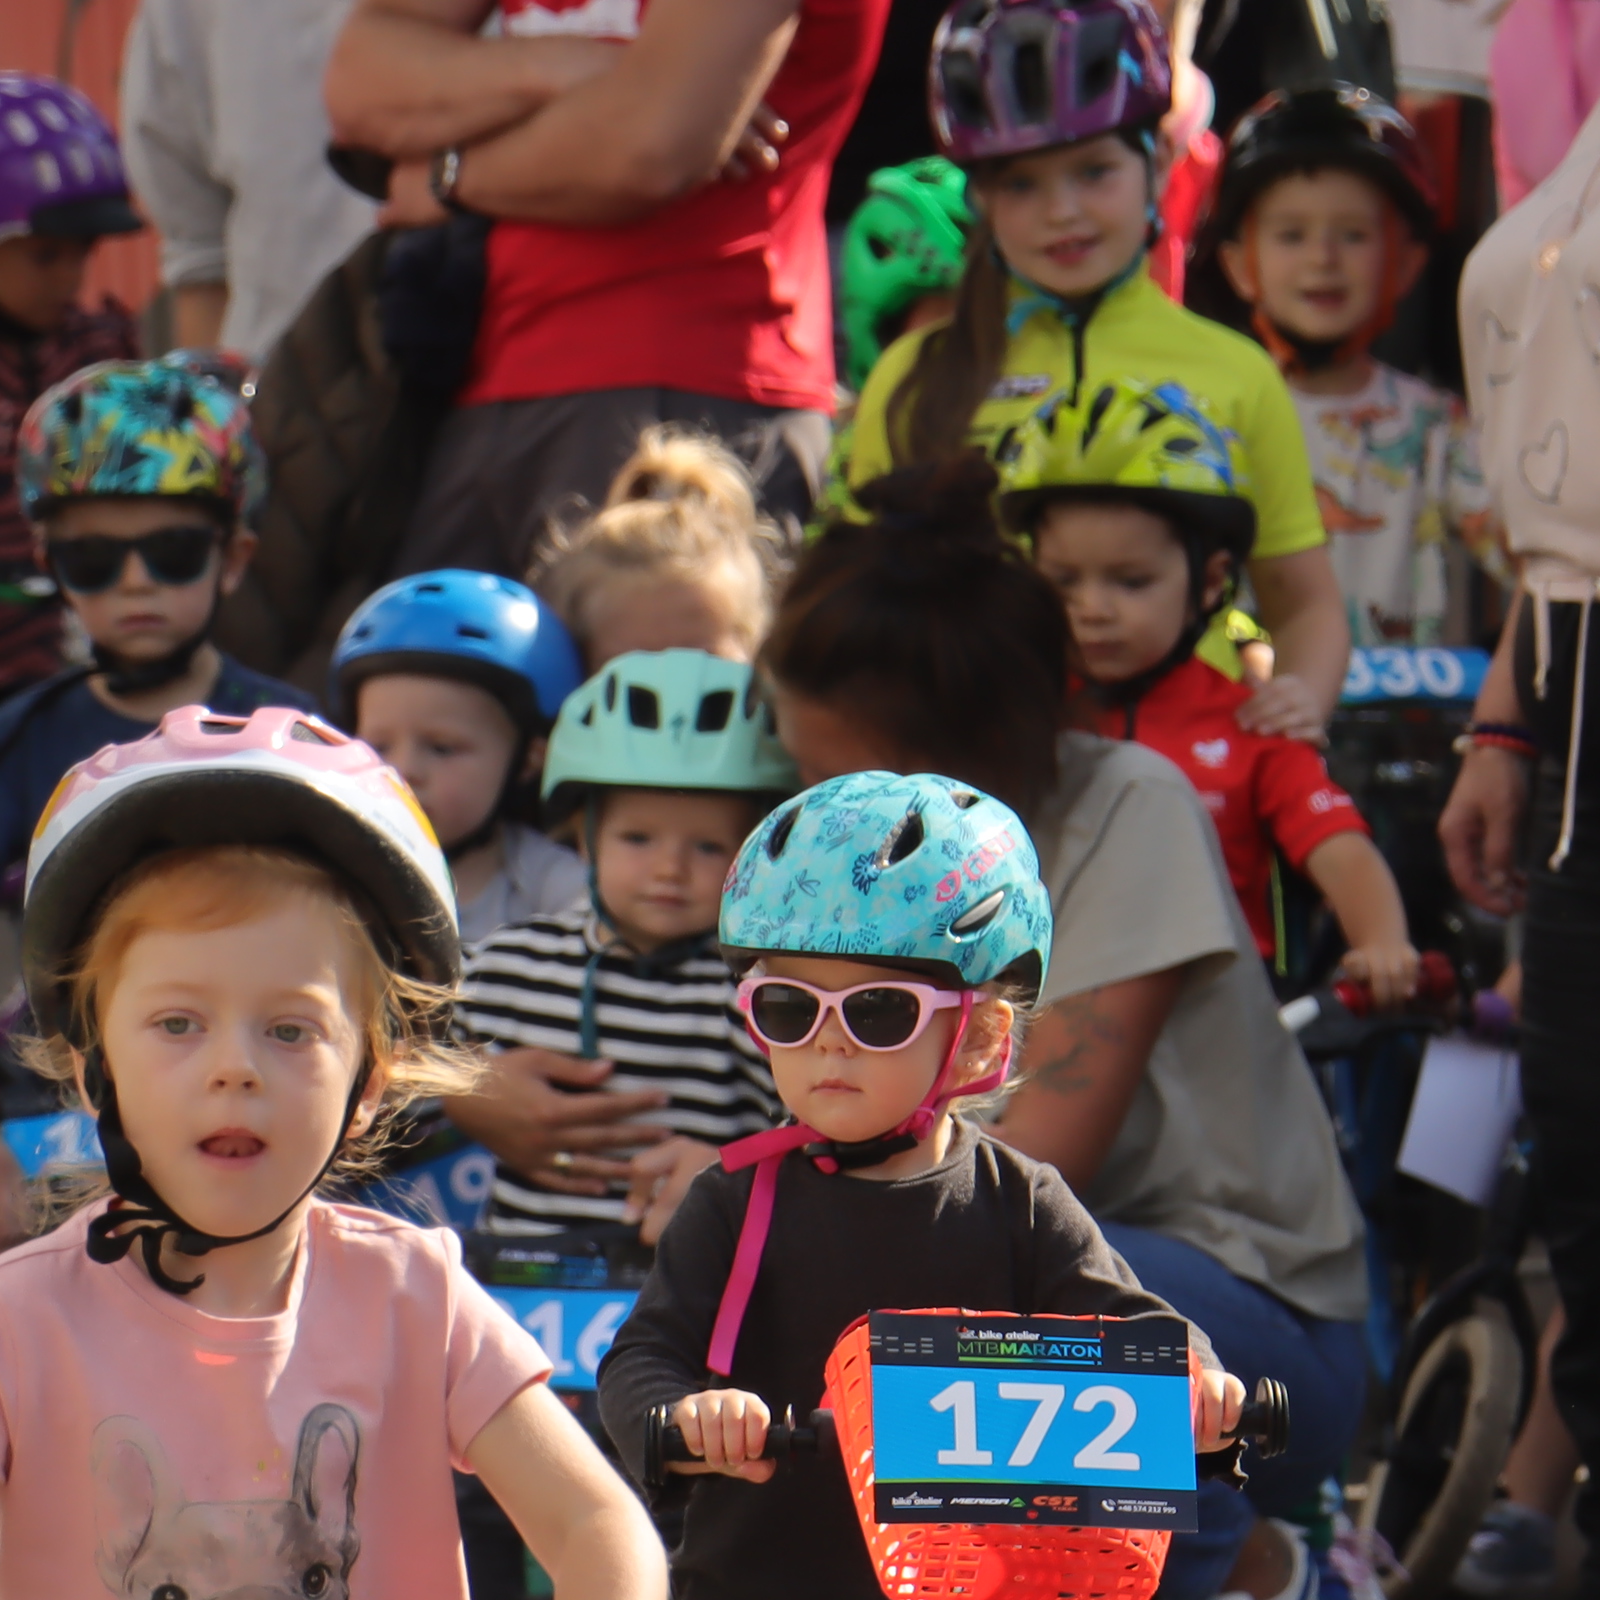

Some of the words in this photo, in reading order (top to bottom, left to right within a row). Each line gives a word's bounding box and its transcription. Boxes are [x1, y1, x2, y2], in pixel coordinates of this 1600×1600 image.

[978, 1331, 1003, 1340] bike
[1005, 1331, 1040, 1341] atelier
[957, 1341, 1102, 1358] MTBMARATON
[929, 1380, 1140, 1471] 172
[892, 1497, 911, 1506] bike
[914, 1496, 943, 1505] atelier
[950, 1497, 1010, 1505] MERIDA
[1032, 1496, 1078, 1507] CST
[1133, 1505, 1147, 1513] 574
